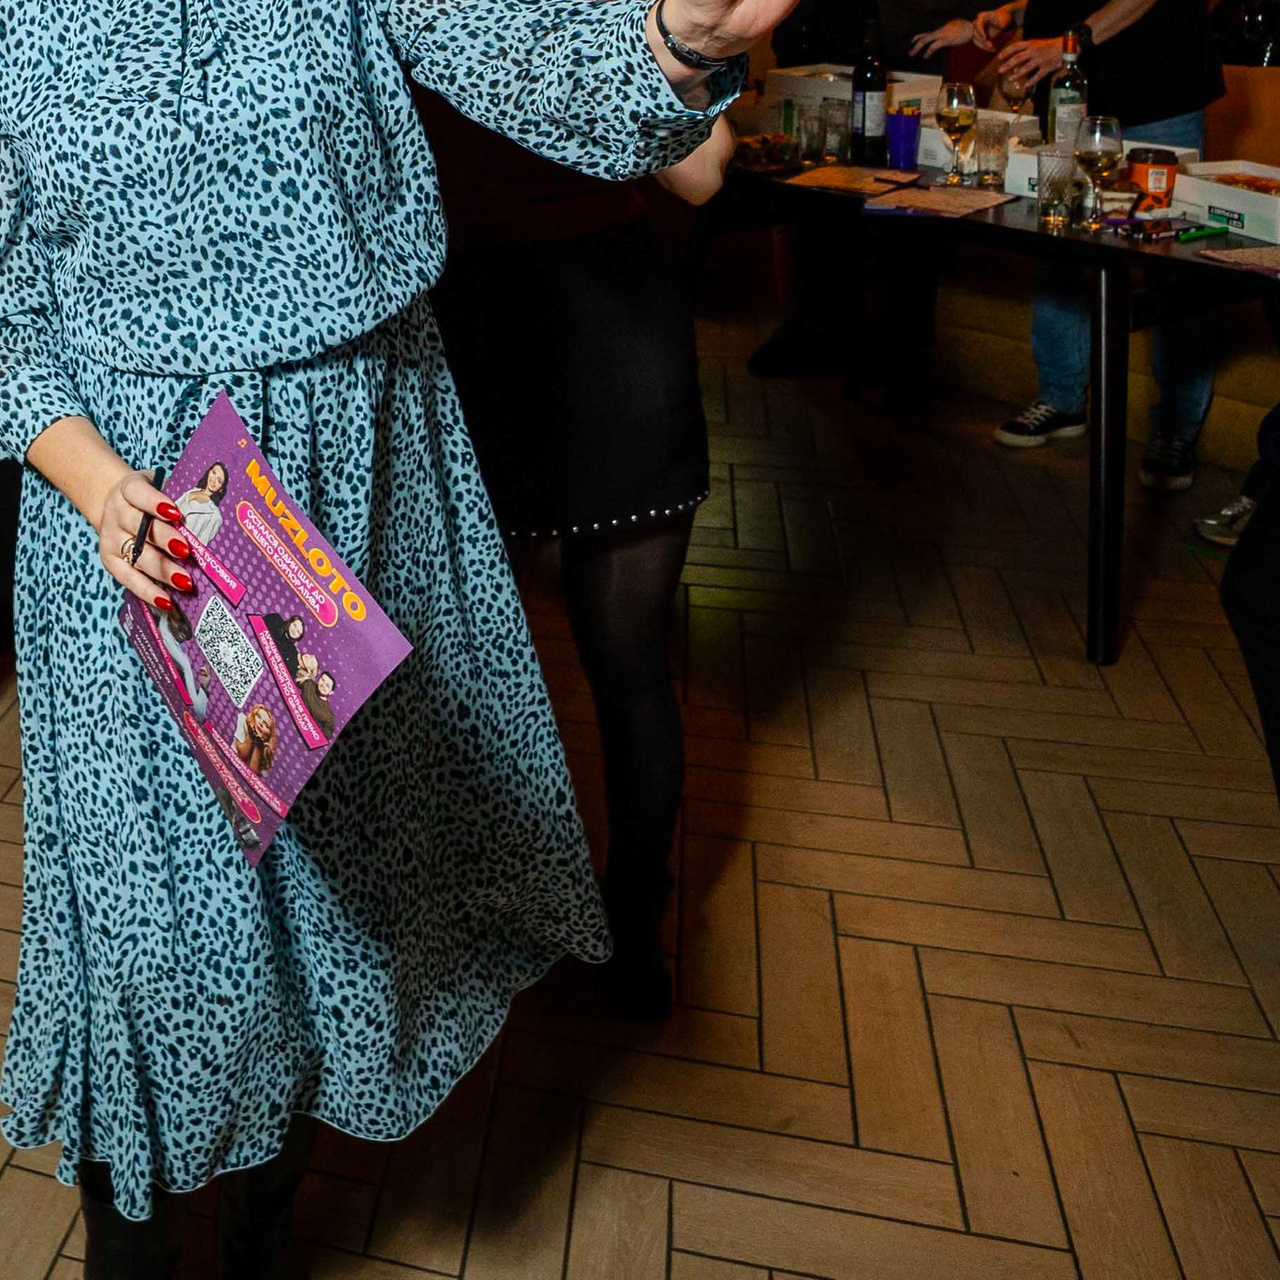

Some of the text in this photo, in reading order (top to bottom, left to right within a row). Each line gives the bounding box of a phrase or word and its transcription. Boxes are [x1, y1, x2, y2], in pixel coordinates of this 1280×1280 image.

[243, 519, 321, 613] ЛУЧШЕГО КОРПОРАТИВА
[246, 458, 366, 621] MUZLOTO
[247, 510, 326, 604] ОСТАЛСЯ ОДИН ШАГ ДО
[278, 662, 305, 712] КОРПОРАТИВ
